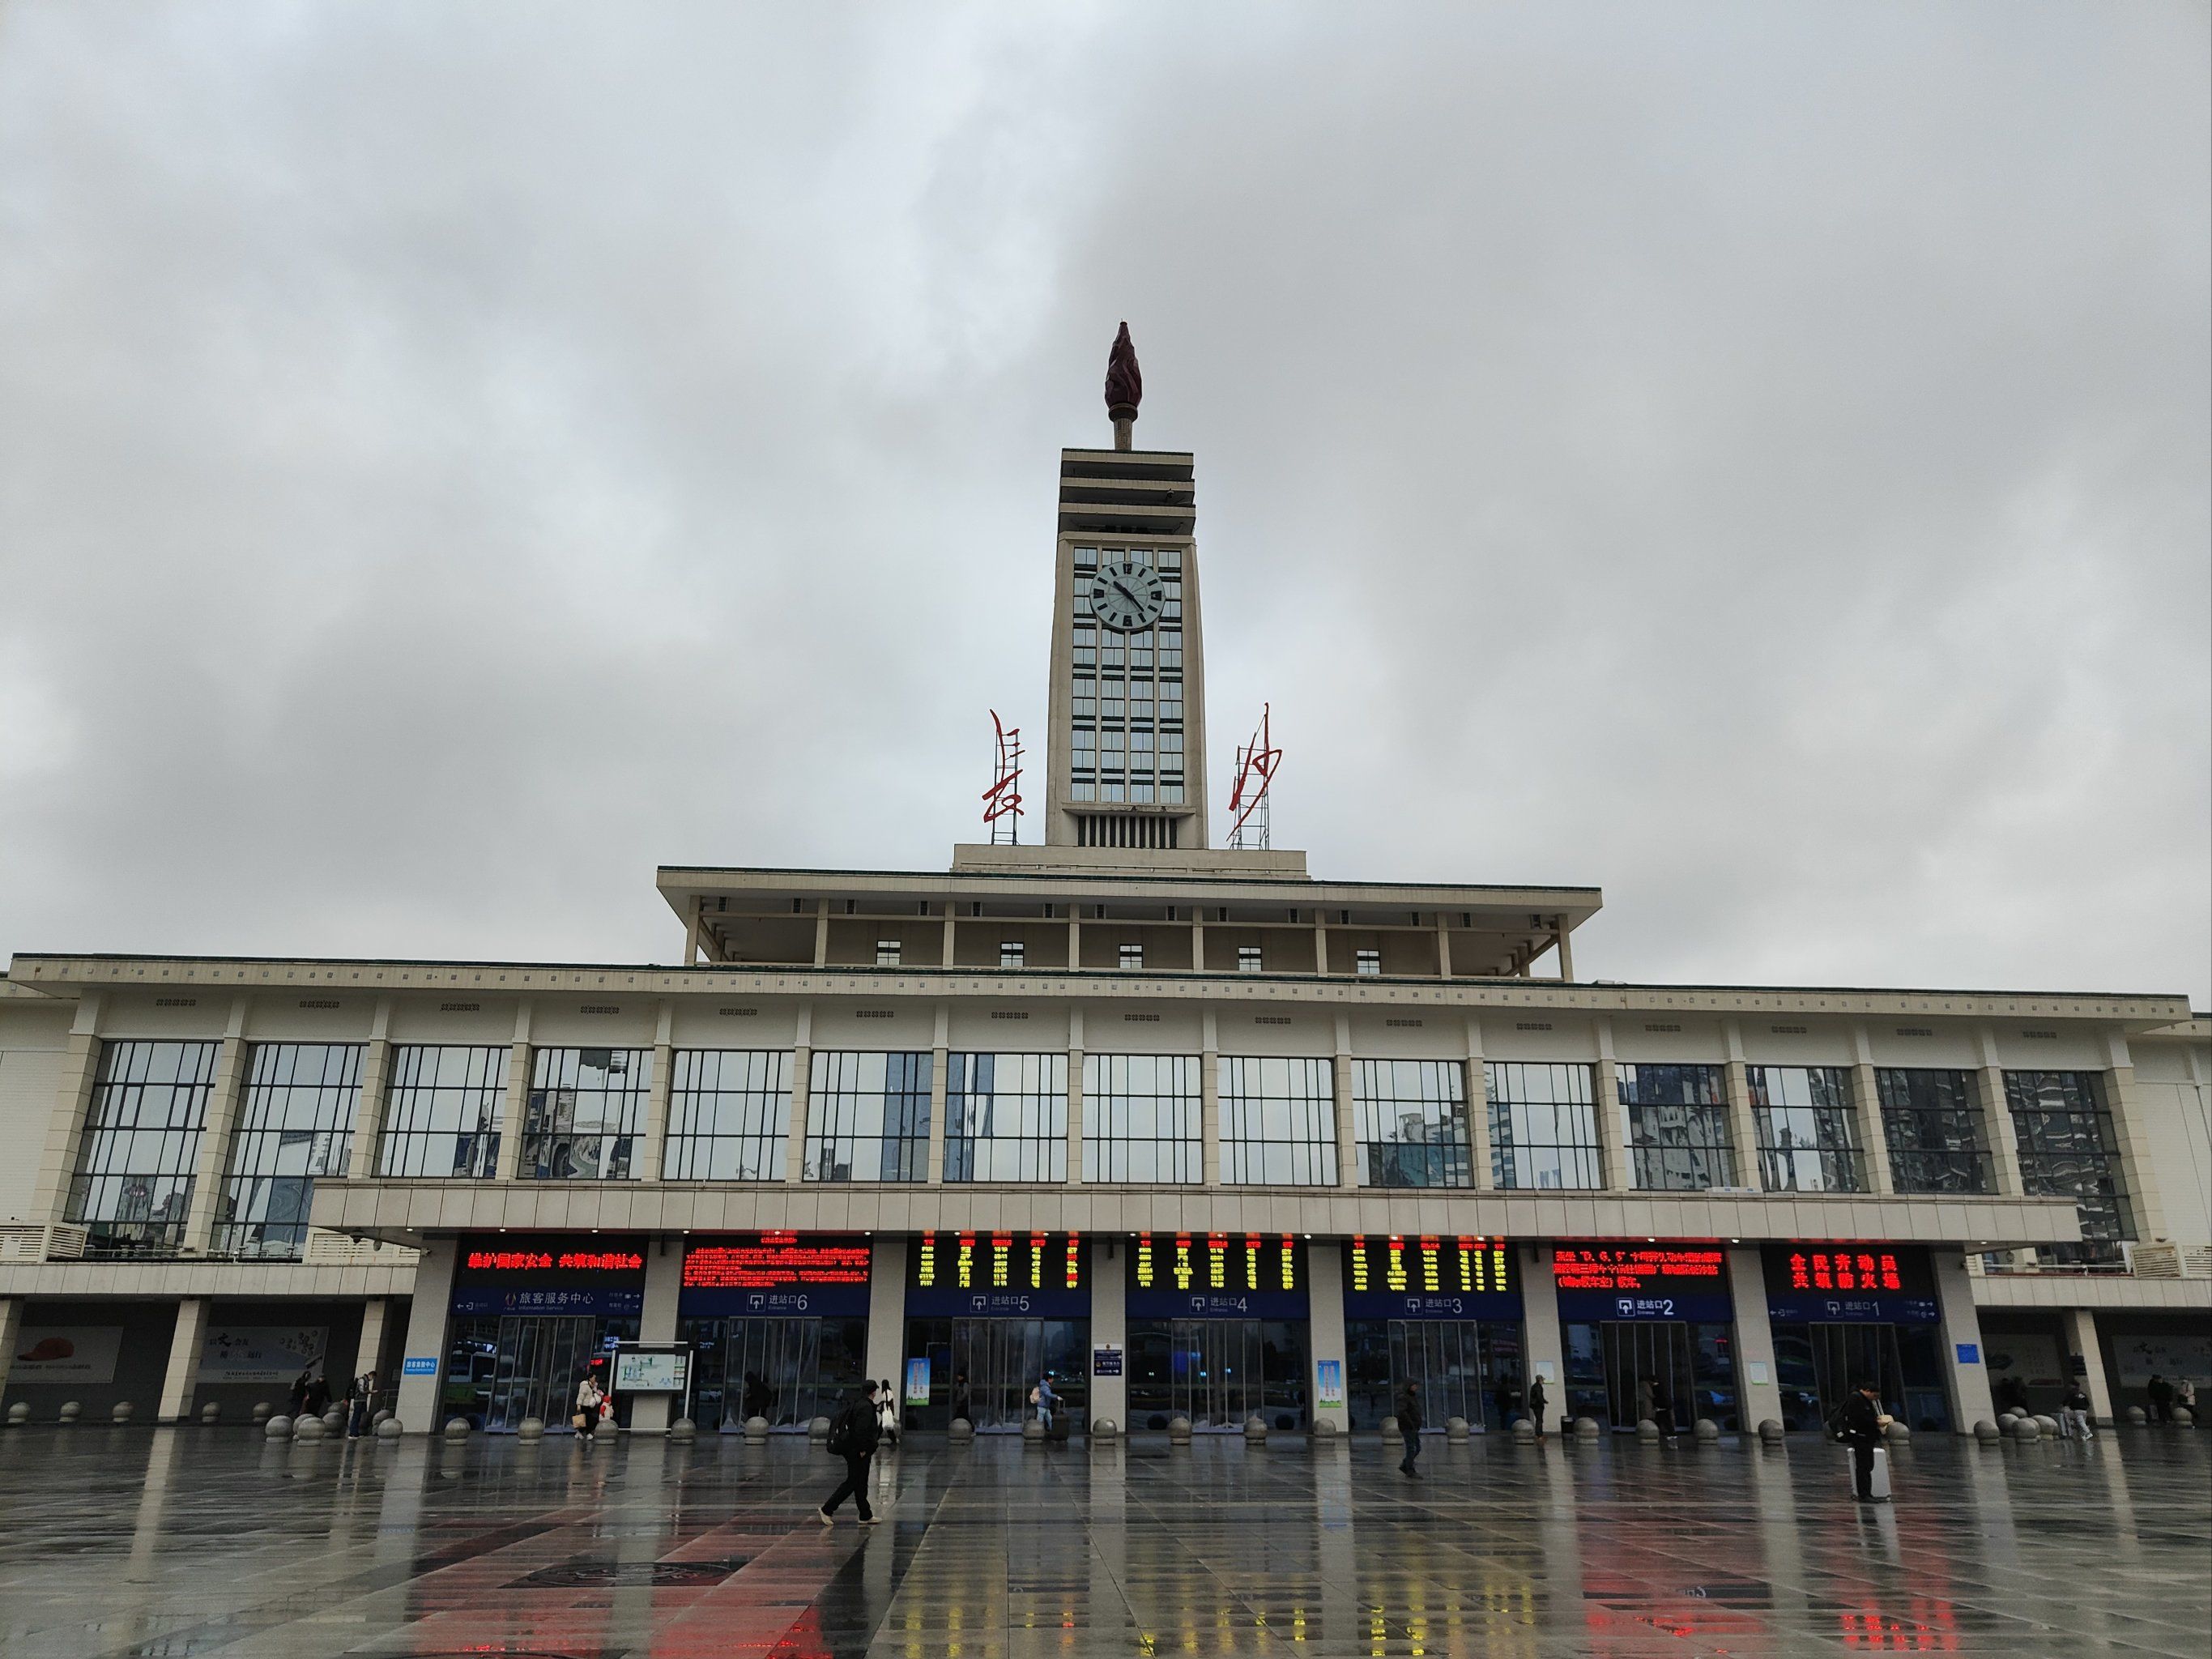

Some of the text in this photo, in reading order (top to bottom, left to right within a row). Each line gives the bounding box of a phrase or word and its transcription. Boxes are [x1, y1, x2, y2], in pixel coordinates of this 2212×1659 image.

[467, 1252, 642, 1269] 维护国家安全 共筑和谐社会
[1790, 1254, 1898, 1271] 全民齐动员
[519, 1291, 594, 1304] 旅客服务中心
